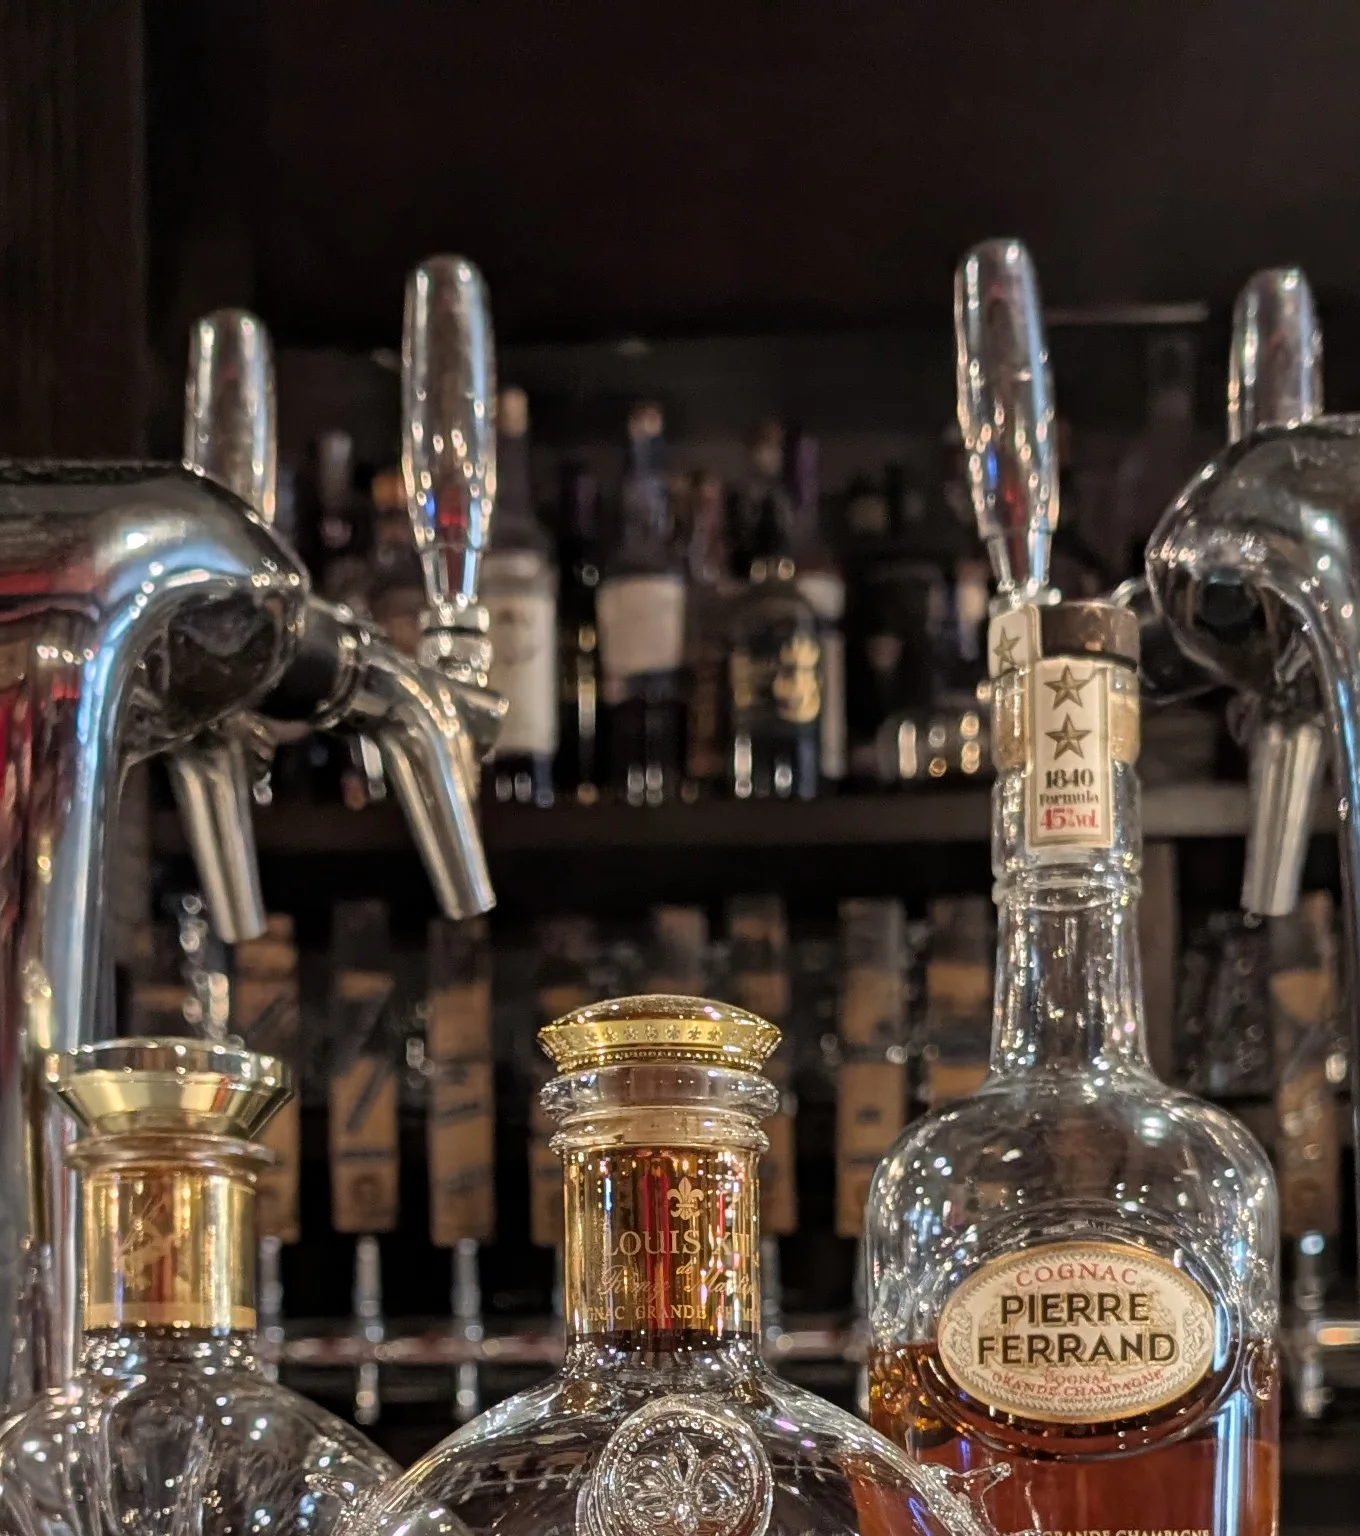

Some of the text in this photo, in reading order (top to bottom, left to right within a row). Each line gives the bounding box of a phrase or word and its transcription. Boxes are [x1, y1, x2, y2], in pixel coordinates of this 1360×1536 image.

[1045, 768, 1095, 789] 1840
[604, 1230, 702, 1256] LOUIS
[1015, 1262, 1139, 1287] COGNAC
[635, 1303, 707, 1321] GRANDE
[1000, 1293, 1151, 1326] PIERRE
[978, 1333, 1178, 1365] FERRAND
